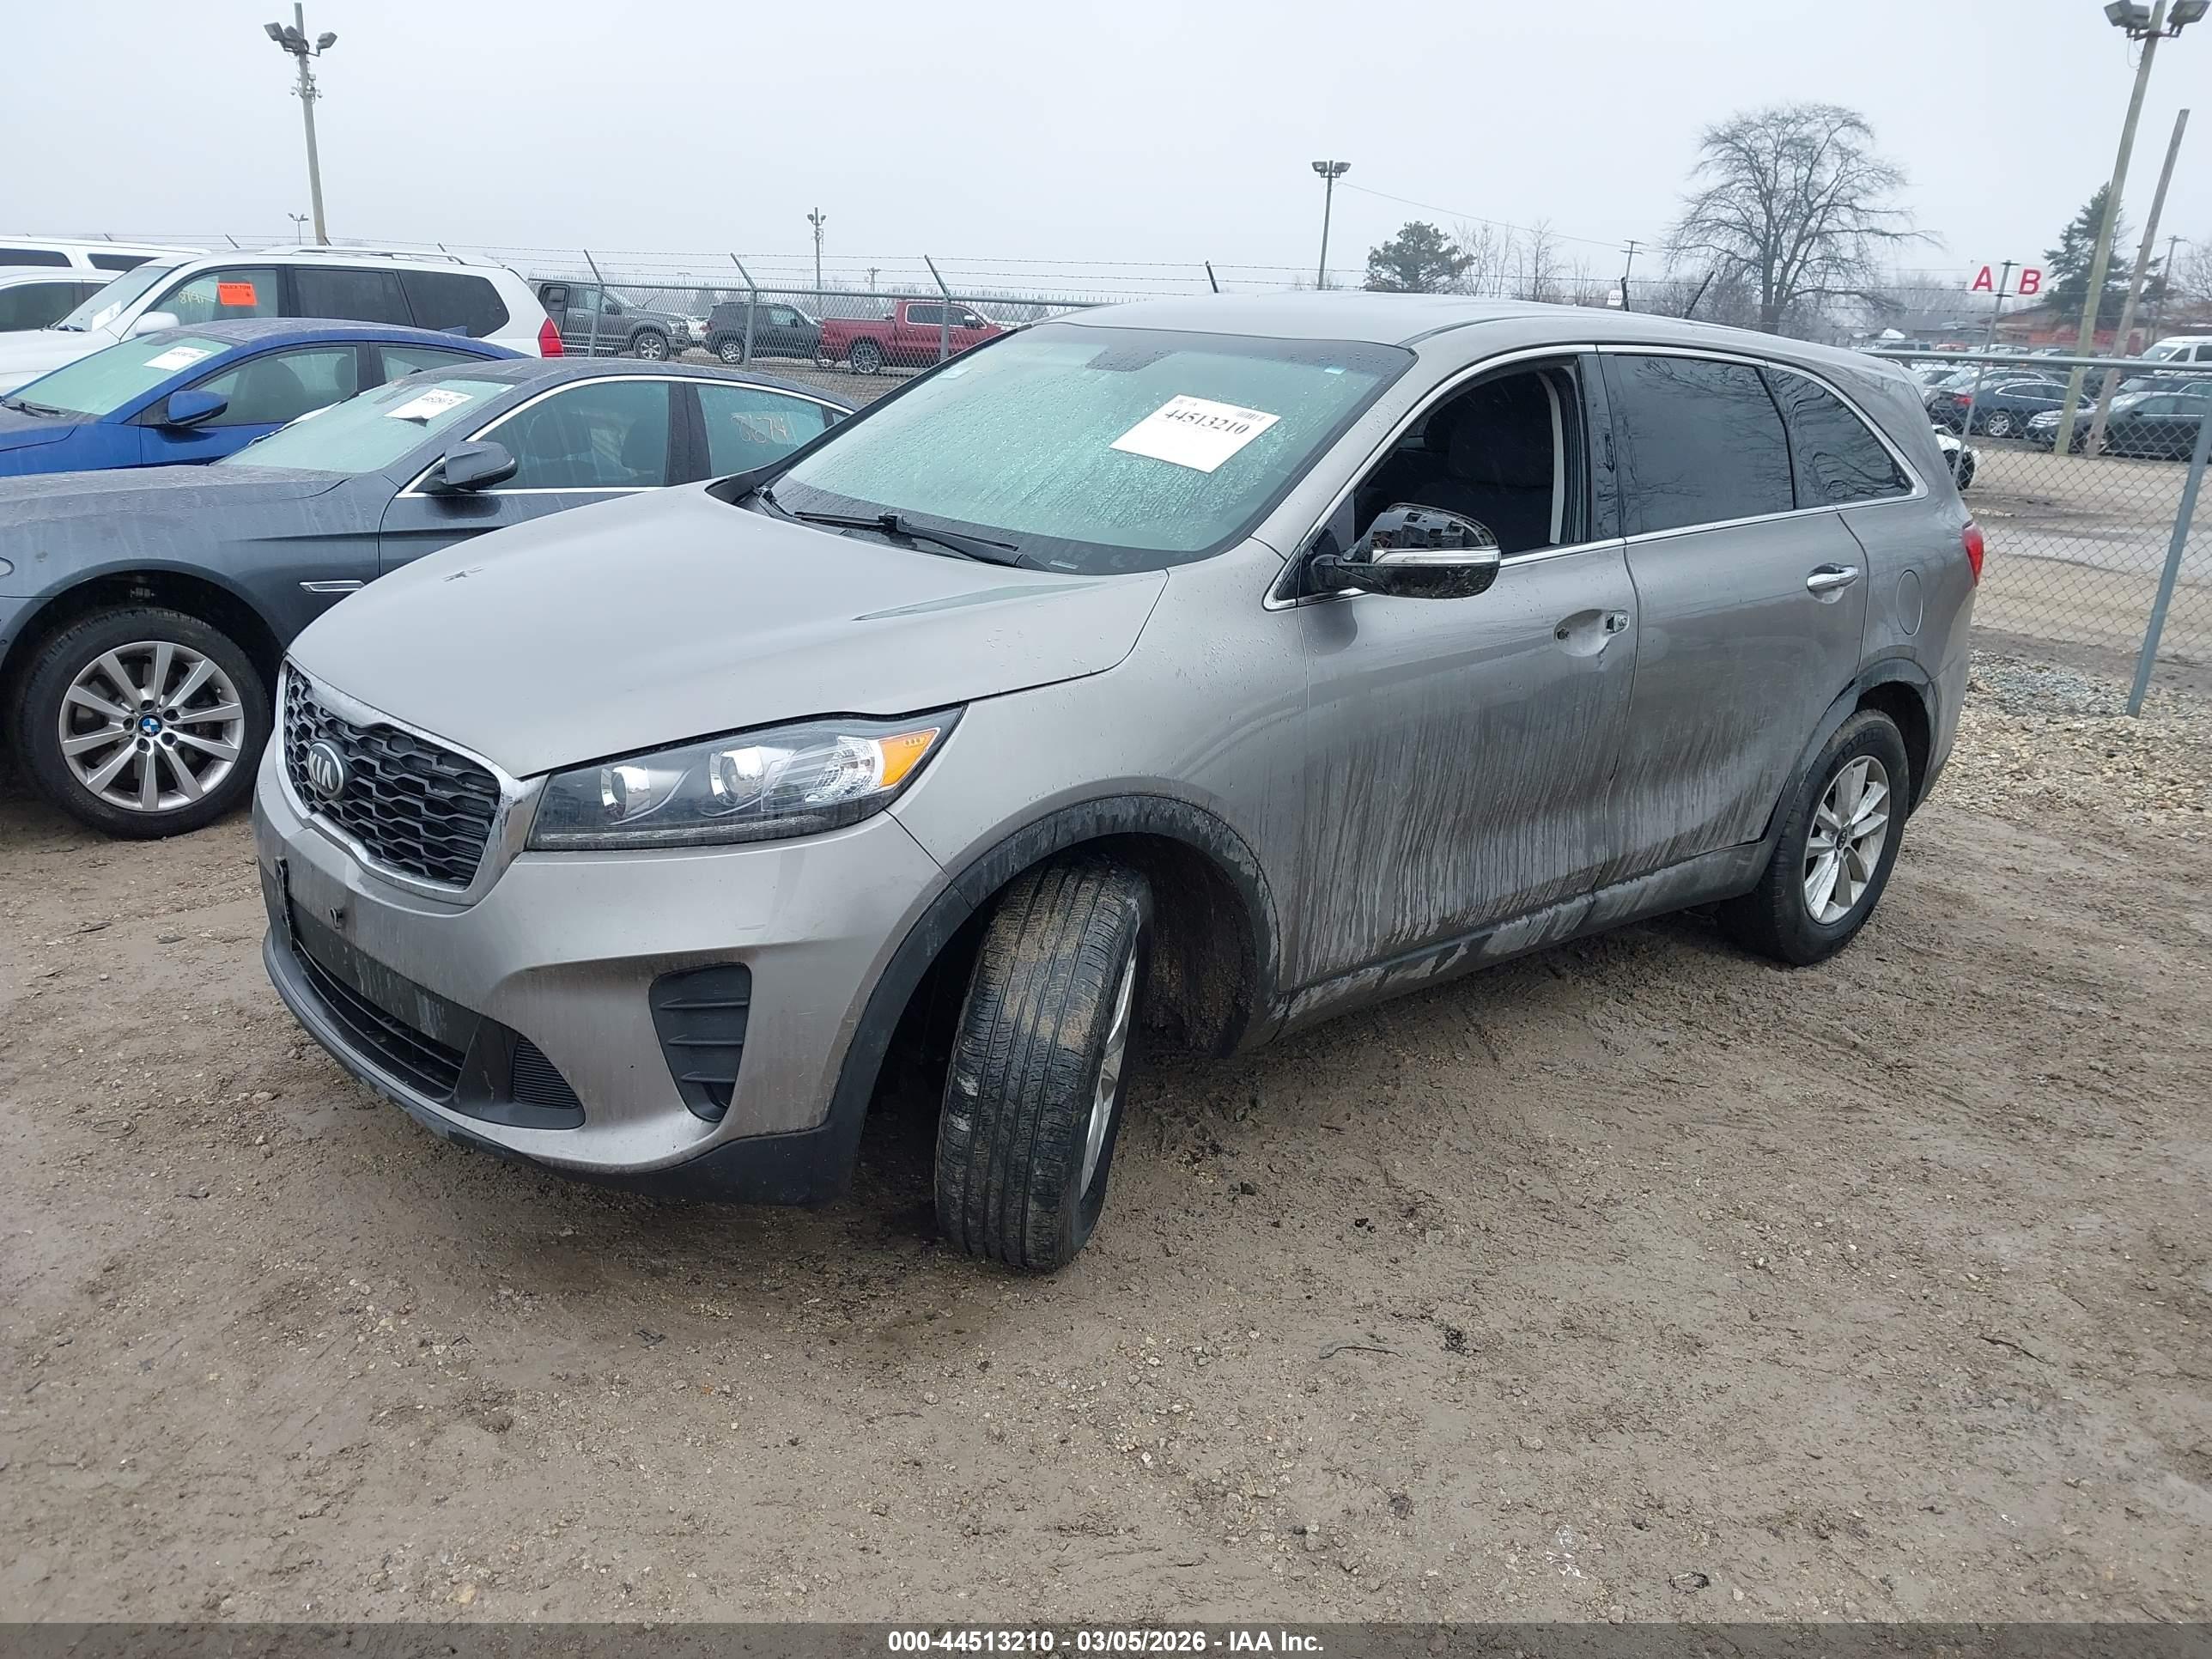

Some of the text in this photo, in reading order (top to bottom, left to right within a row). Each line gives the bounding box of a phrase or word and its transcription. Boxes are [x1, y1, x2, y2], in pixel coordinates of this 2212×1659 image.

[1972, 265, 1993, 292] A
[2018, 268, 2043, 295] B
[1164, 410, 1250, 435] 44513210
[307, 750, 334, 791] KIA
